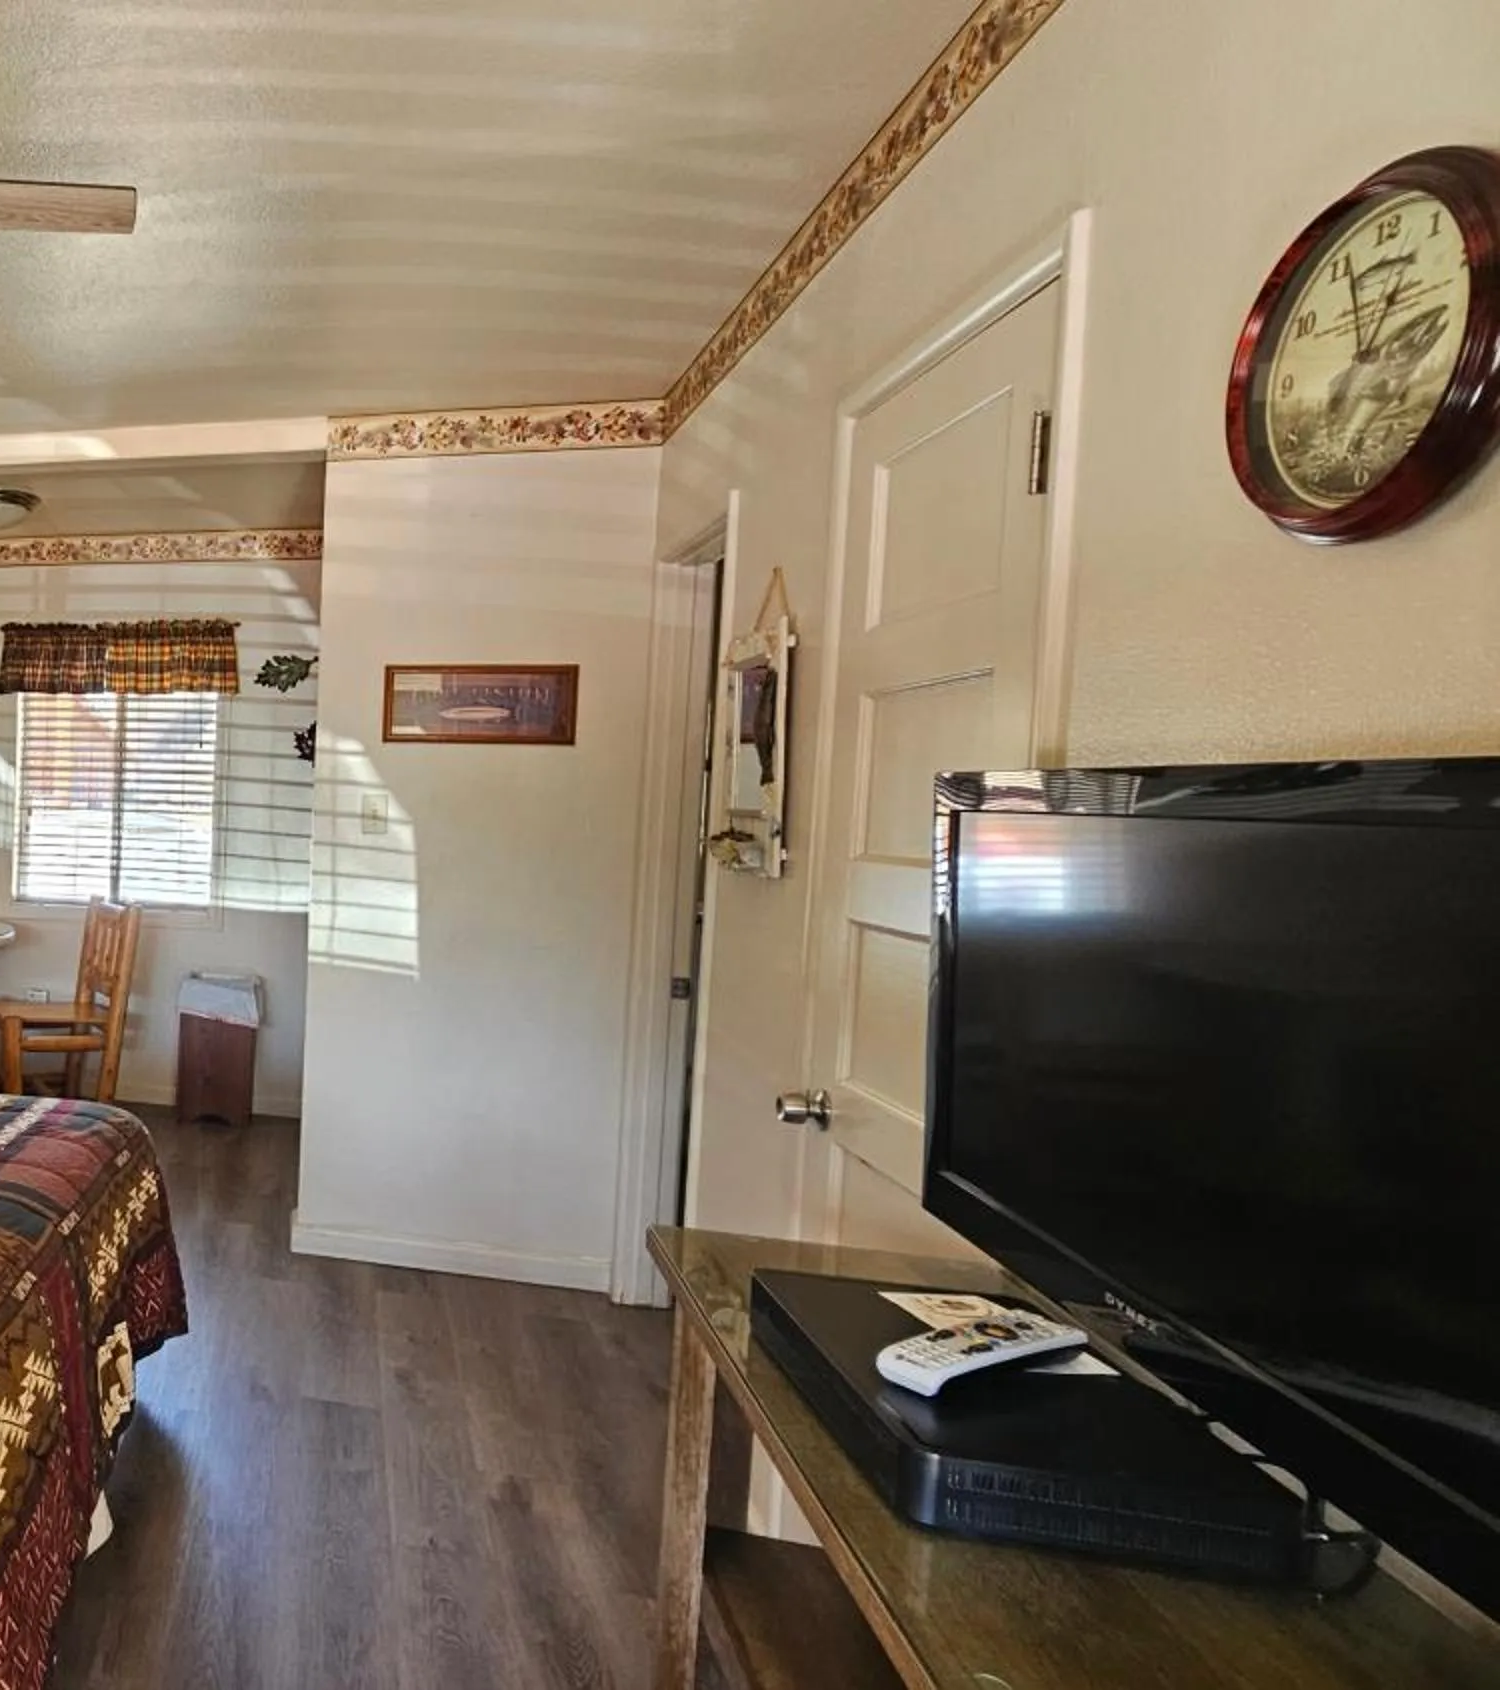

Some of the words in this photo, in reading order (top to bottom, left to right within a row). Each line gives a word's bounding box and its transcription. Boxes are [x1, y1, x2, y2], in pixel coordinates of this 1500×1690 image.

[1374, 214, 1402, 248] 12
[1427, 210, 1442, 239] 1
[1328, 253, 1351, 285] 11
[1293, 311, 1317, 341] 10
[1281, 374, 1295, 398] 9
[1104, 1290, 1158, 1337] DYNEX
